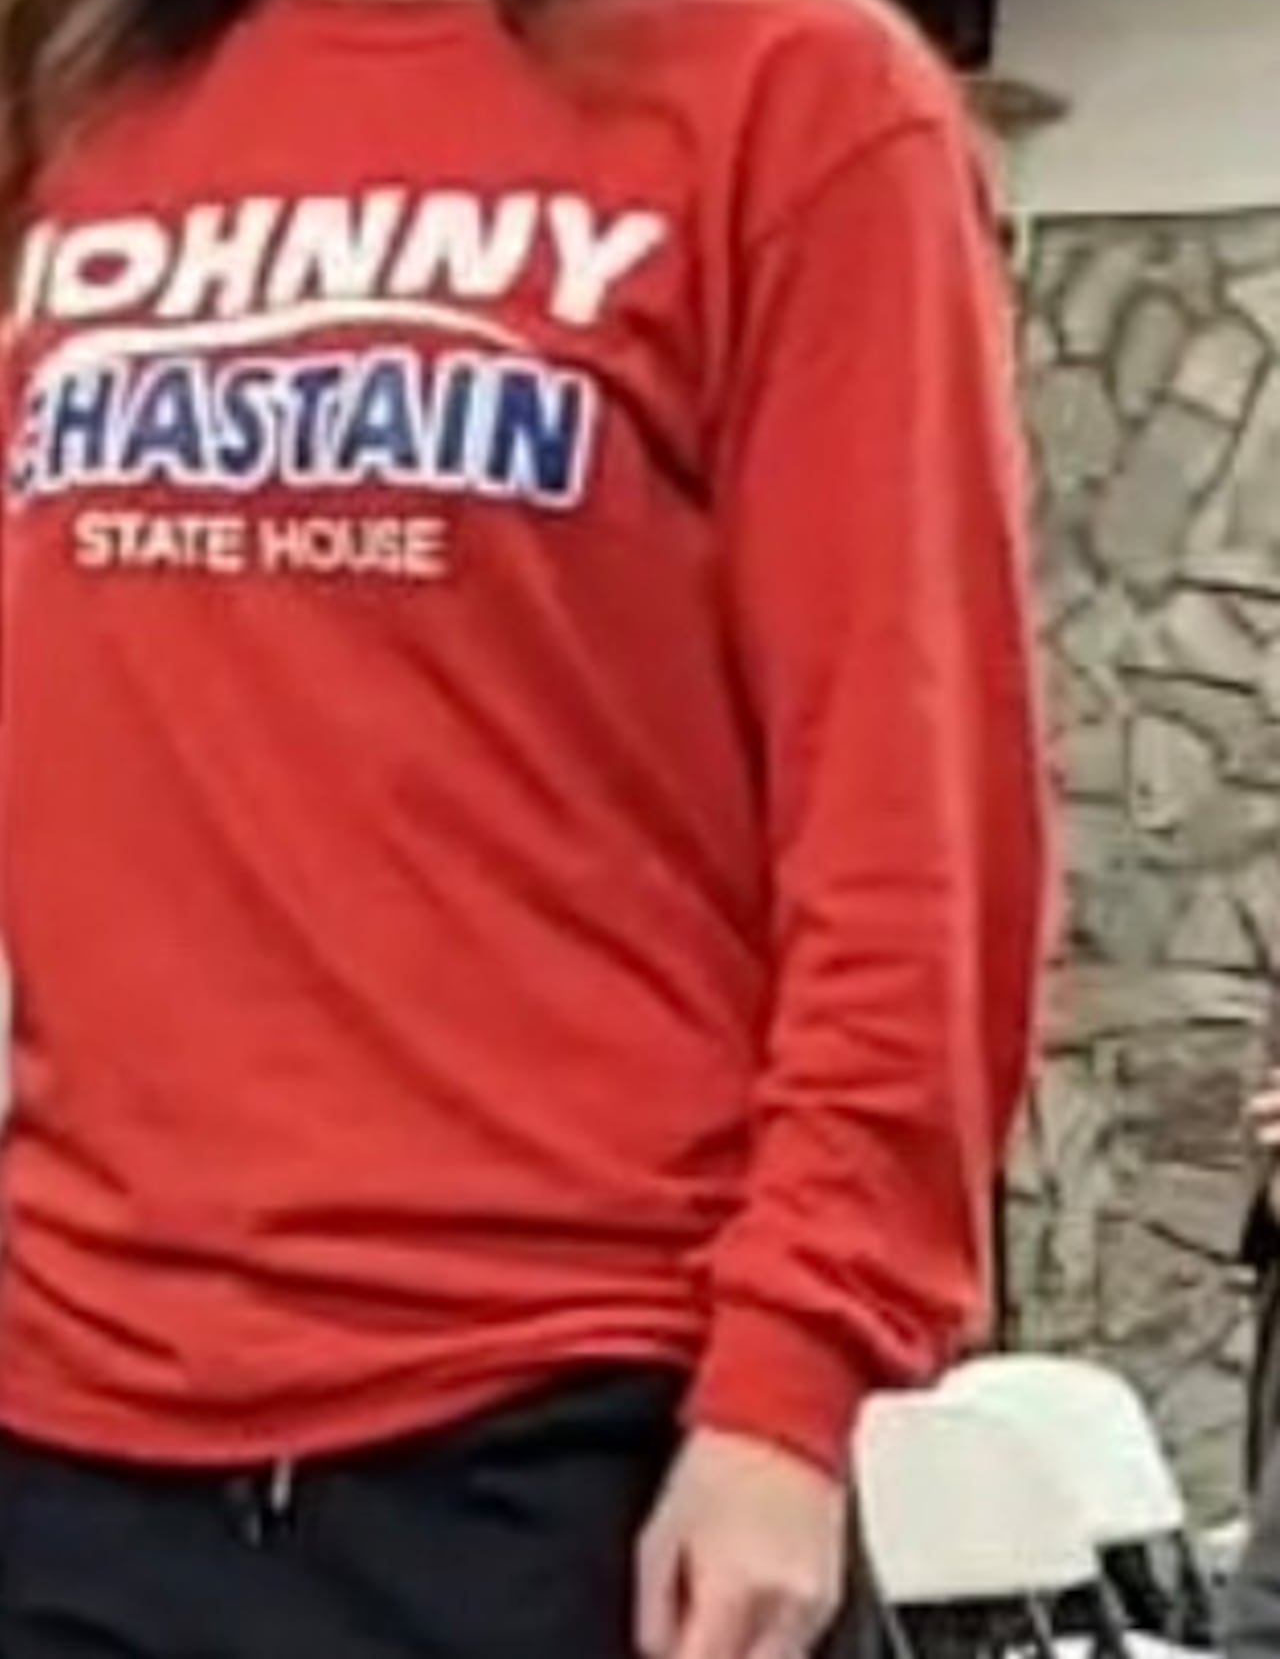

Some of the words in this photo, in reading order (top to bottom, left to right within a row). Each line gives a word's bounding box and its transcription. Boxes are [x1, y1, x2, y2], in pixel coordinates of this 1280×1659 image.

[8, 348, 596, 506] HASTAIN
[74, 512, 244, 574] STATE
[260, 516, 448, 578] HOUSE
